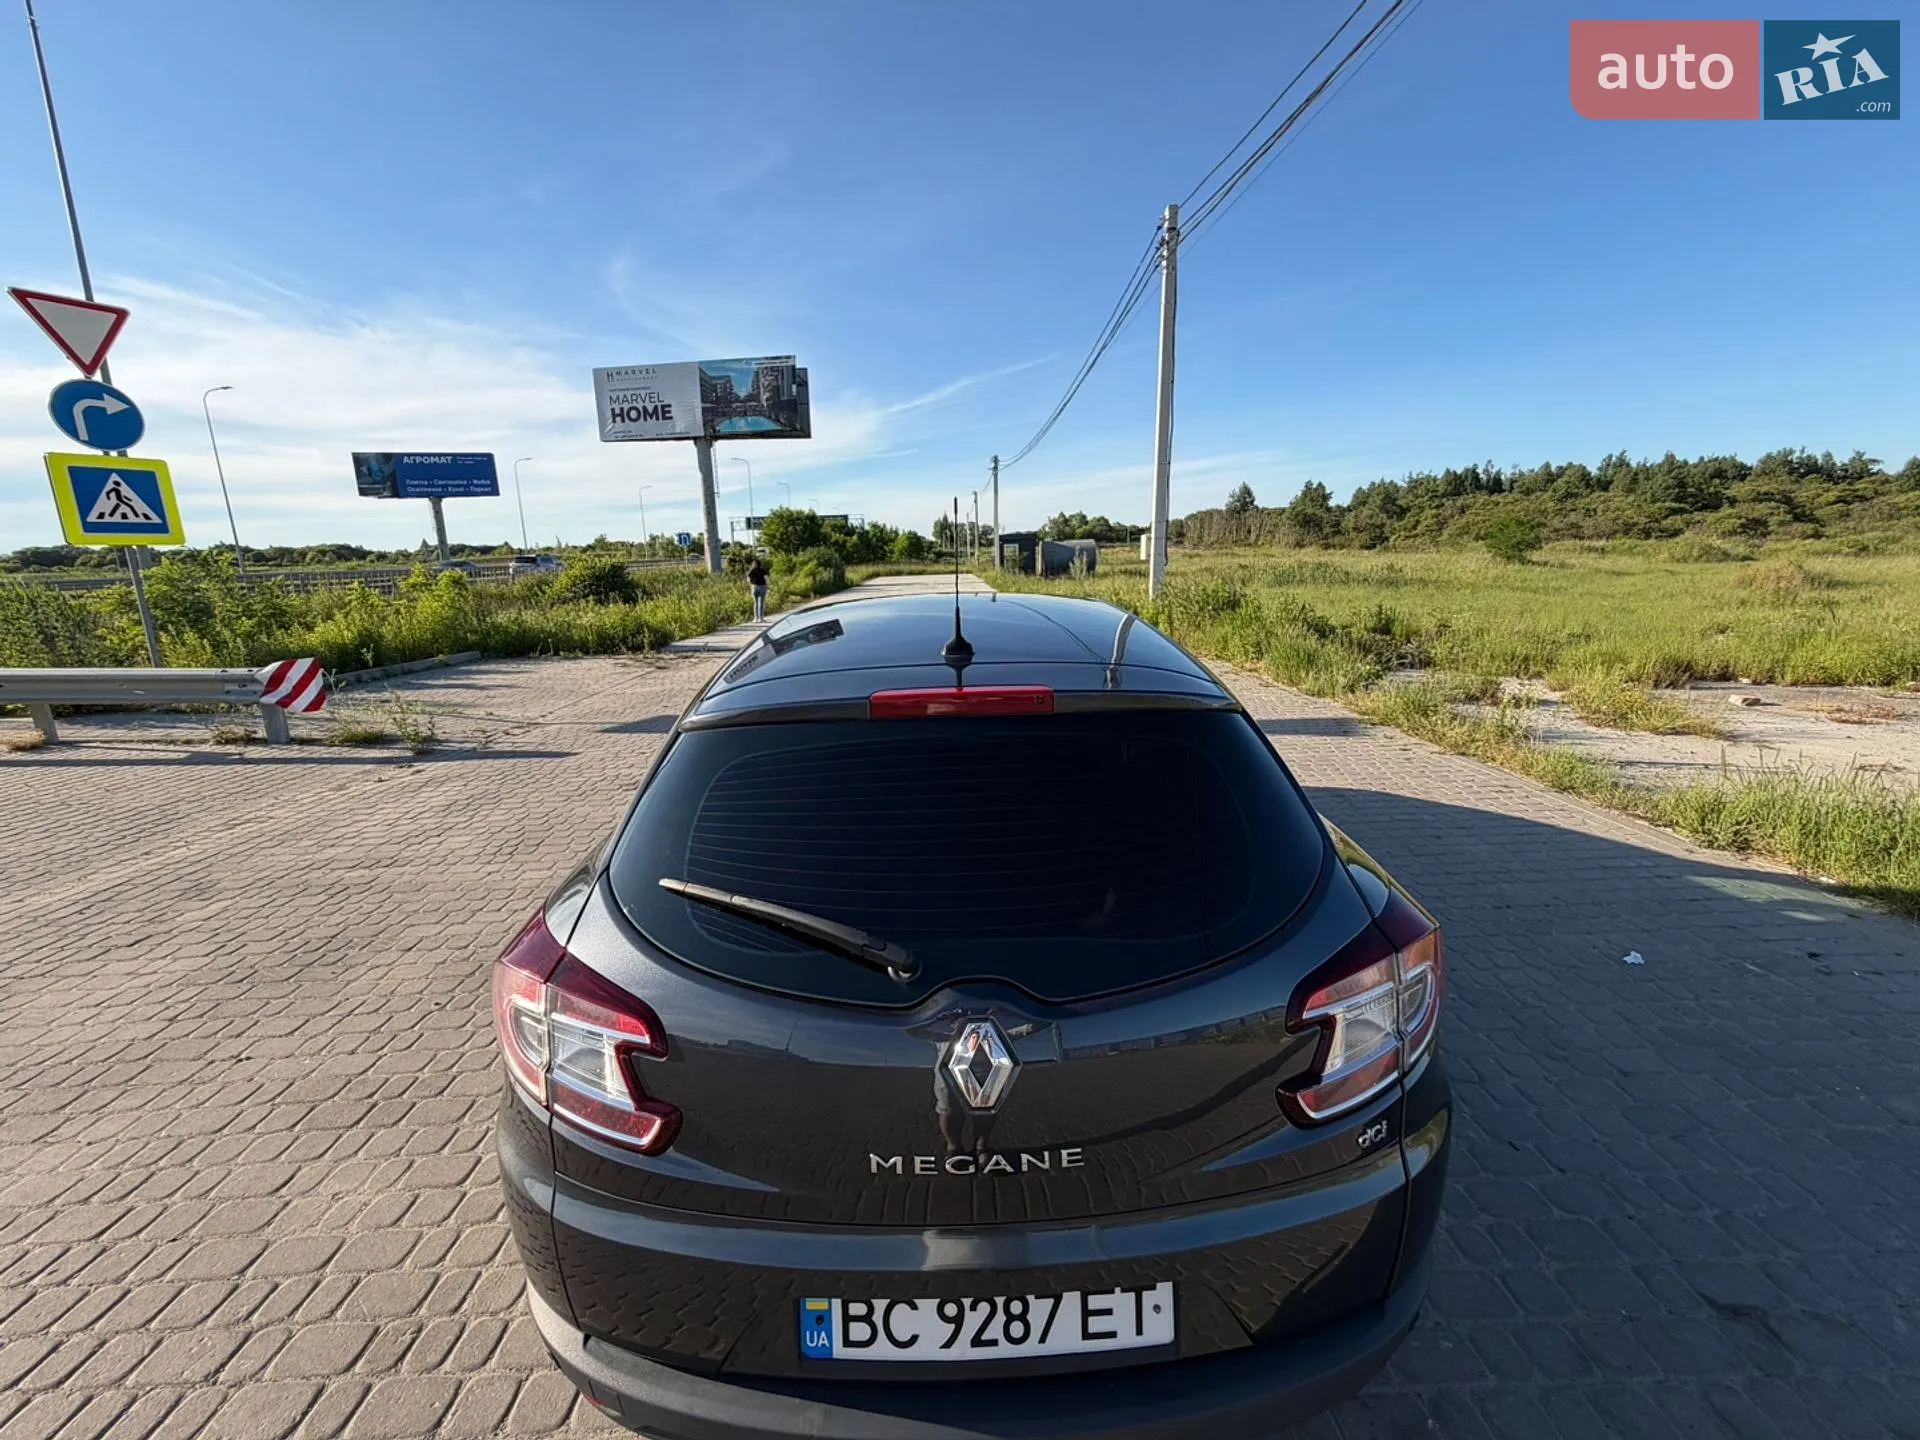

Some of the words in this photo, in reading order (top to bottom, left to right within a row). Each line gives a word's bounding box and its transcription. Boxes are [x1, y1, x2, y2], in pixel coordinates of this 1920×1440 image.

[616, 367, 658, 377] MARVEL
[609, 391, 665, 406] MARVEL
[610, 403, 674, 424] HOME
[403, 455, 453, 464] АГРОМАТ
[869, 1147, 1085, 1175] MEGANE
[841, 1297, 920, 1350] BC
[936, 1295, 1064, 1350] 9287
[1080, 1283, 1157, 1341] ET
[805, 1330, 830, 1348] UA
